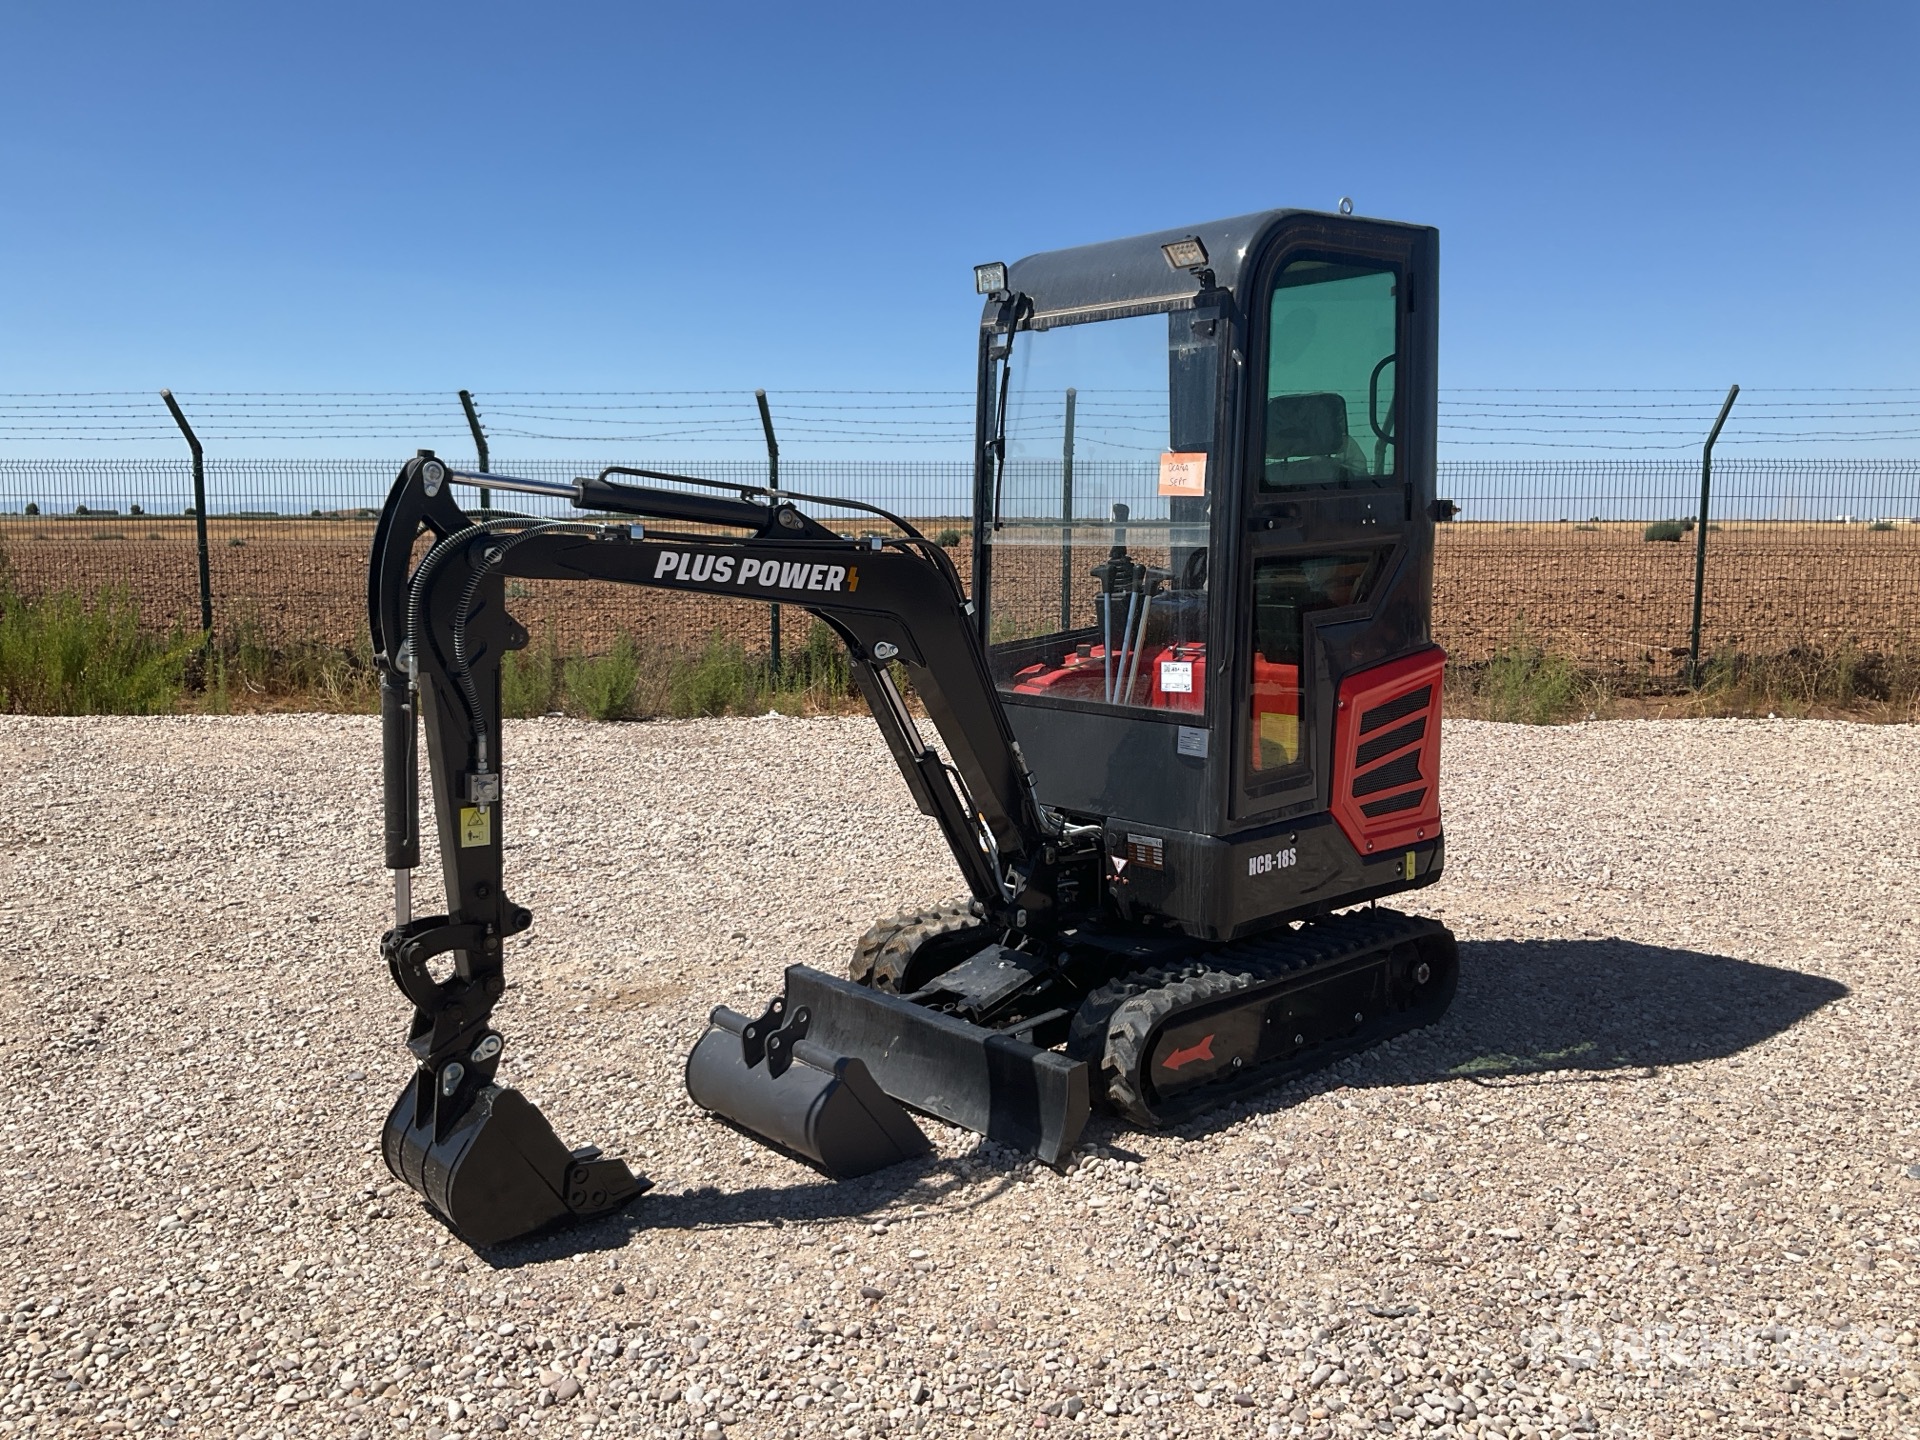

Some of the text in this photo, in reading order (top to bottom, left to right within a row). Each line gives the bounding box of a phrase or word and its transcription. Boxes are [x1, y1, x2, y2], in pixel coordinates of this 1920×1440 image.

[653, 550, 846, 592] PLUS POWER
[1248, 847, 1297, 876] HCB-18S
